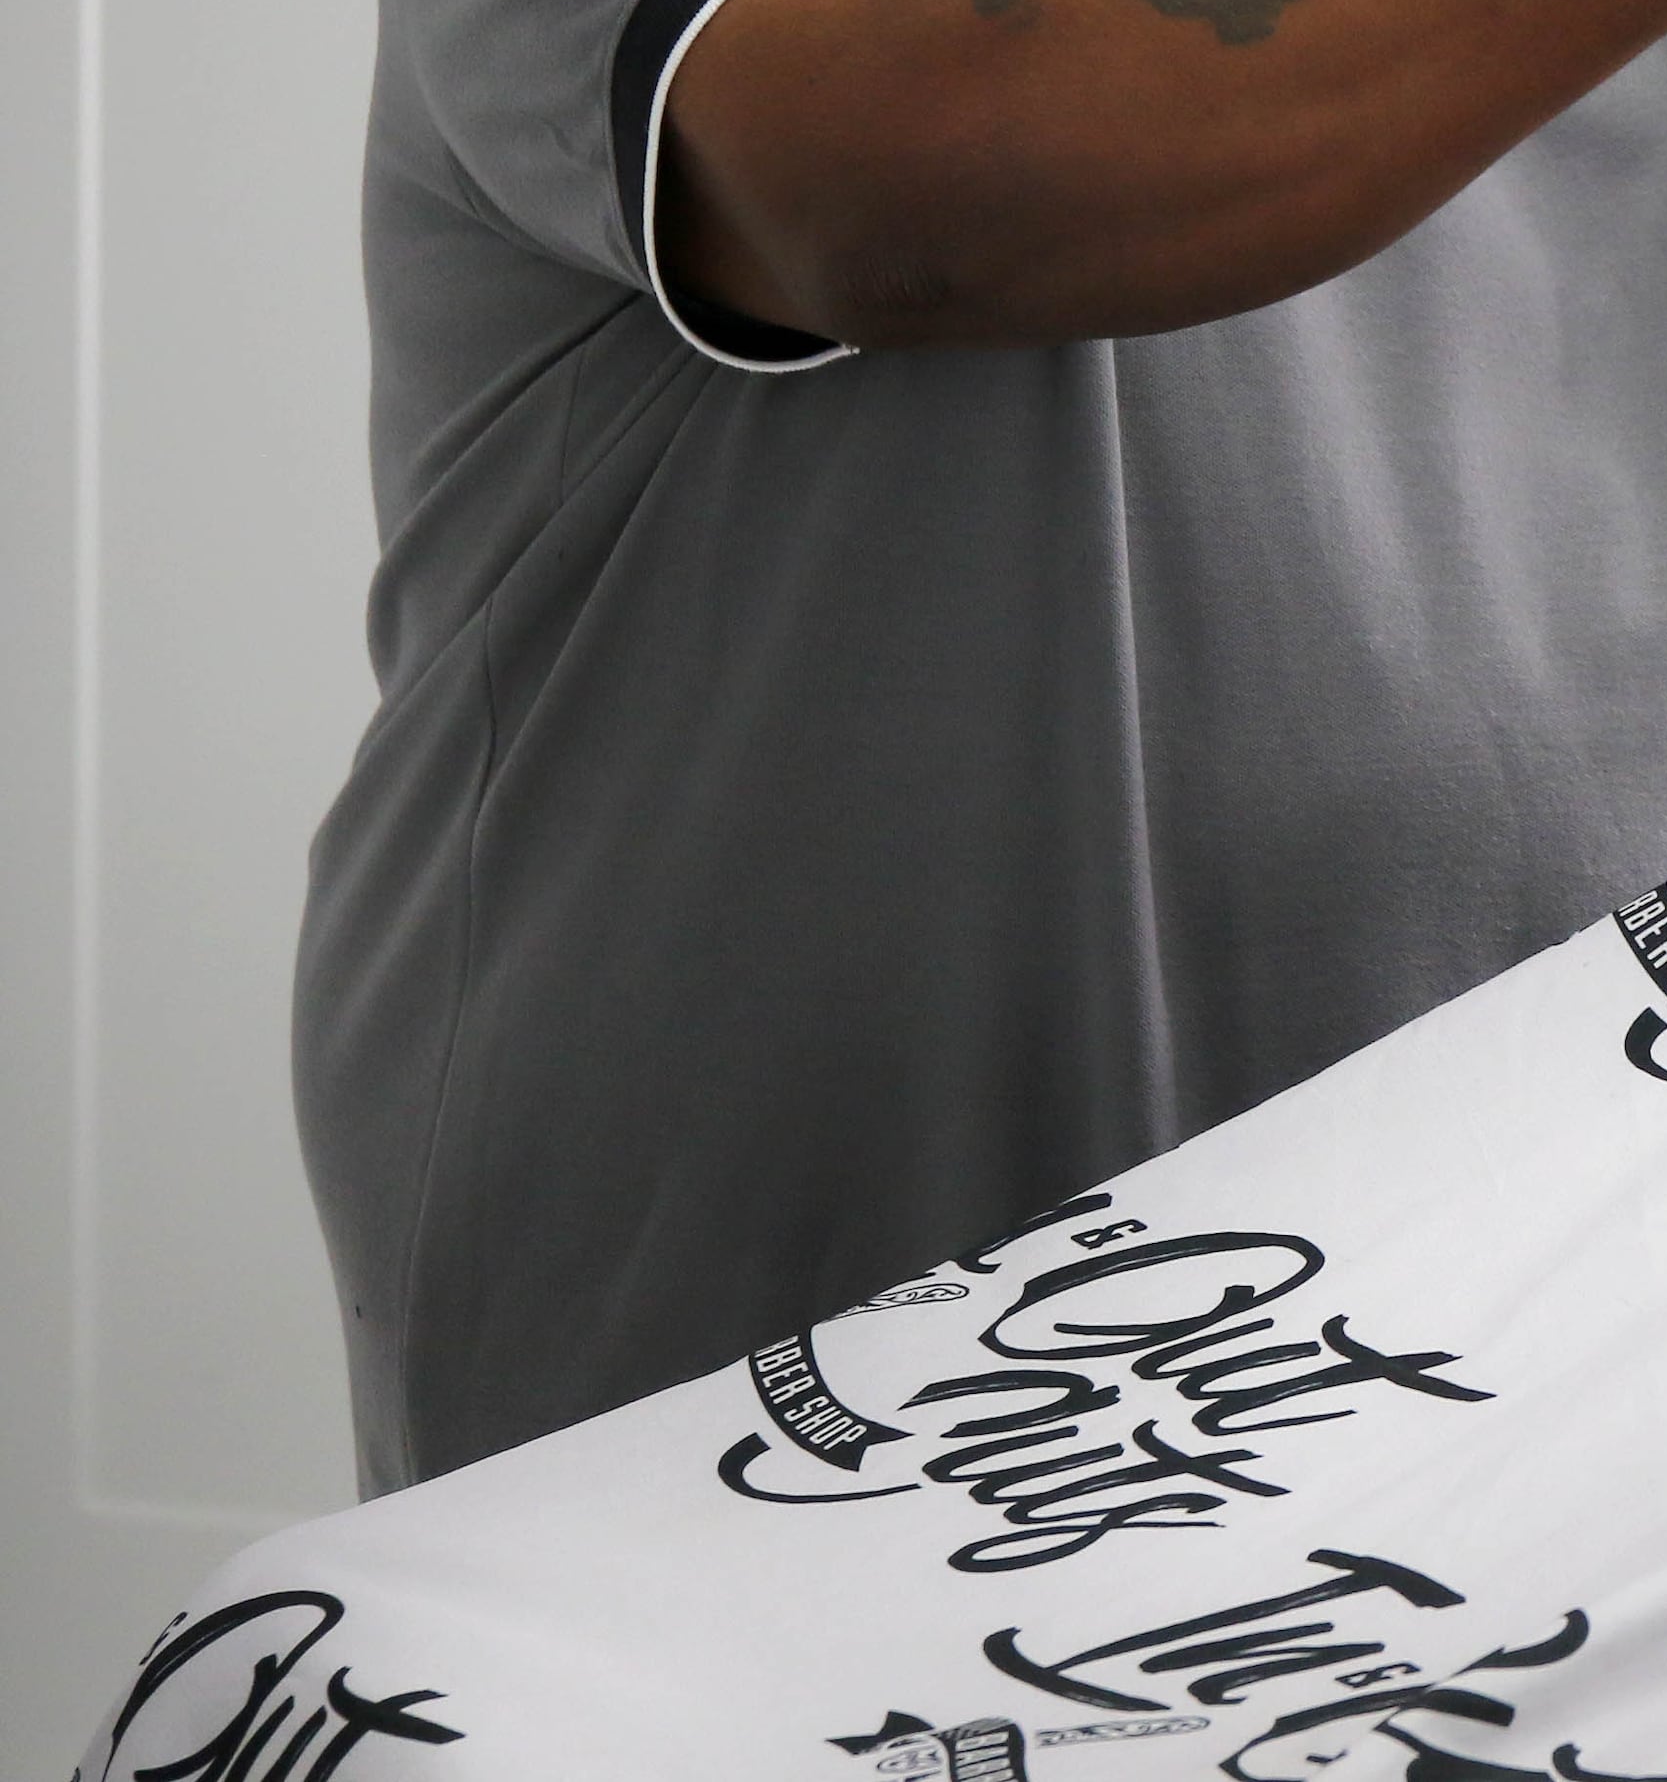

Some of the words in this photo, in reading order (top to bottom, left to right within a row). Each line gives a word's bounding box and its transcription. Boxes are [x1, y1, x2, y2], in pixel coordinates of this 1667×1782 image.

[978, 1231, 1498, 1437] Out
[783, 1395, 868, 1451] SHOP
[982, 1548, 1467, 1711] In
